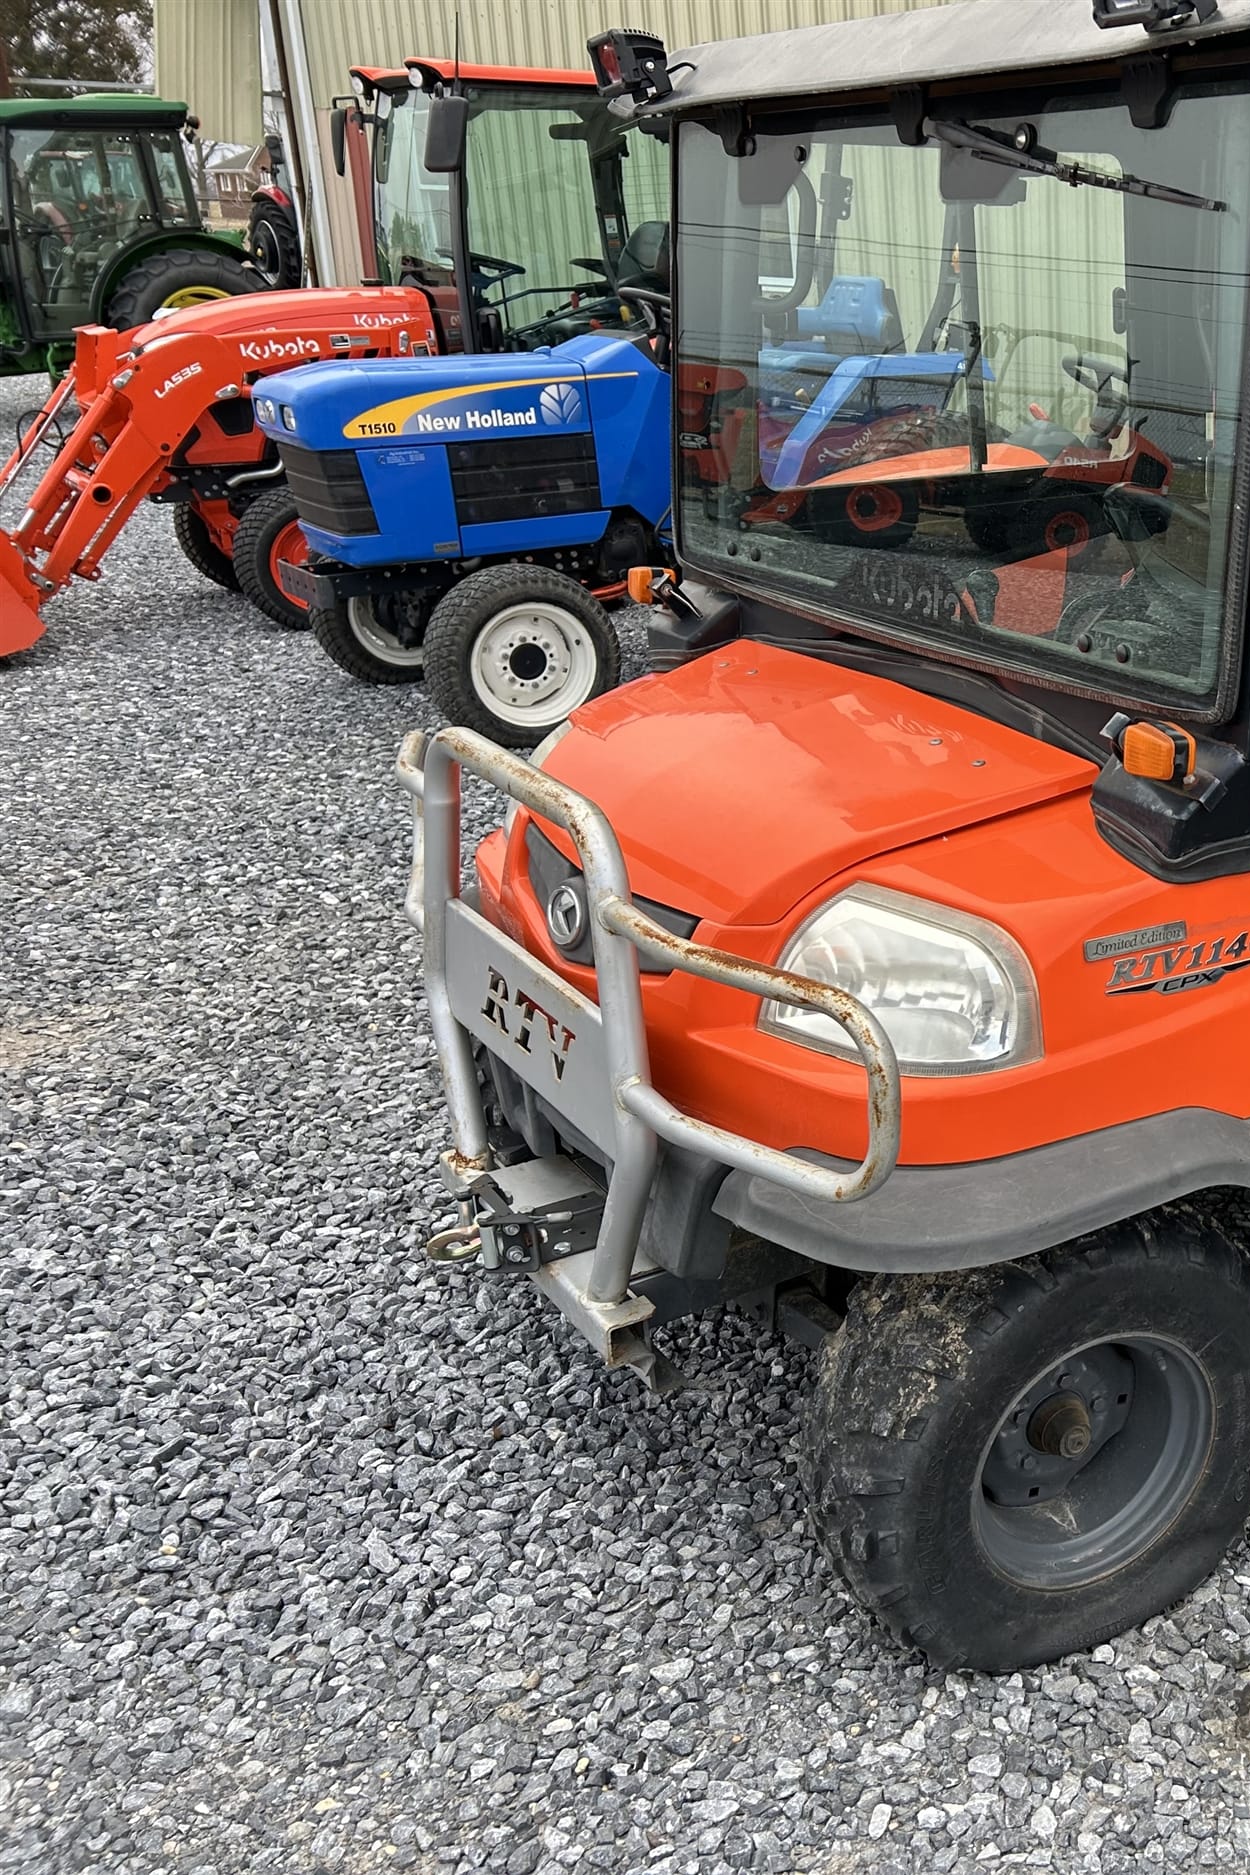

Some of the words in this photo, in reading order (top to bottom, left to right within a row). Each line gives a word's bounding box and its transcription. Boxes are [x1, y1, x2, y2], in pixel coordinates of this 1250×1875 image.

[353, 313, 420, 329] Kubot
[239, 336, 321, 361] Kubota
[153, 361, 203, 399] LA535
[358, 421, 396, 436] T1510
[416, 413, 461, 432] New
[466, 407, 537, 430] Holland
[1092, 934, 1138, 956] Limited
[1140, 927, 1182, 946] Edition
[1161, 968, 1218, 992] CPX
[480, 964, 577, 1083] RTV
